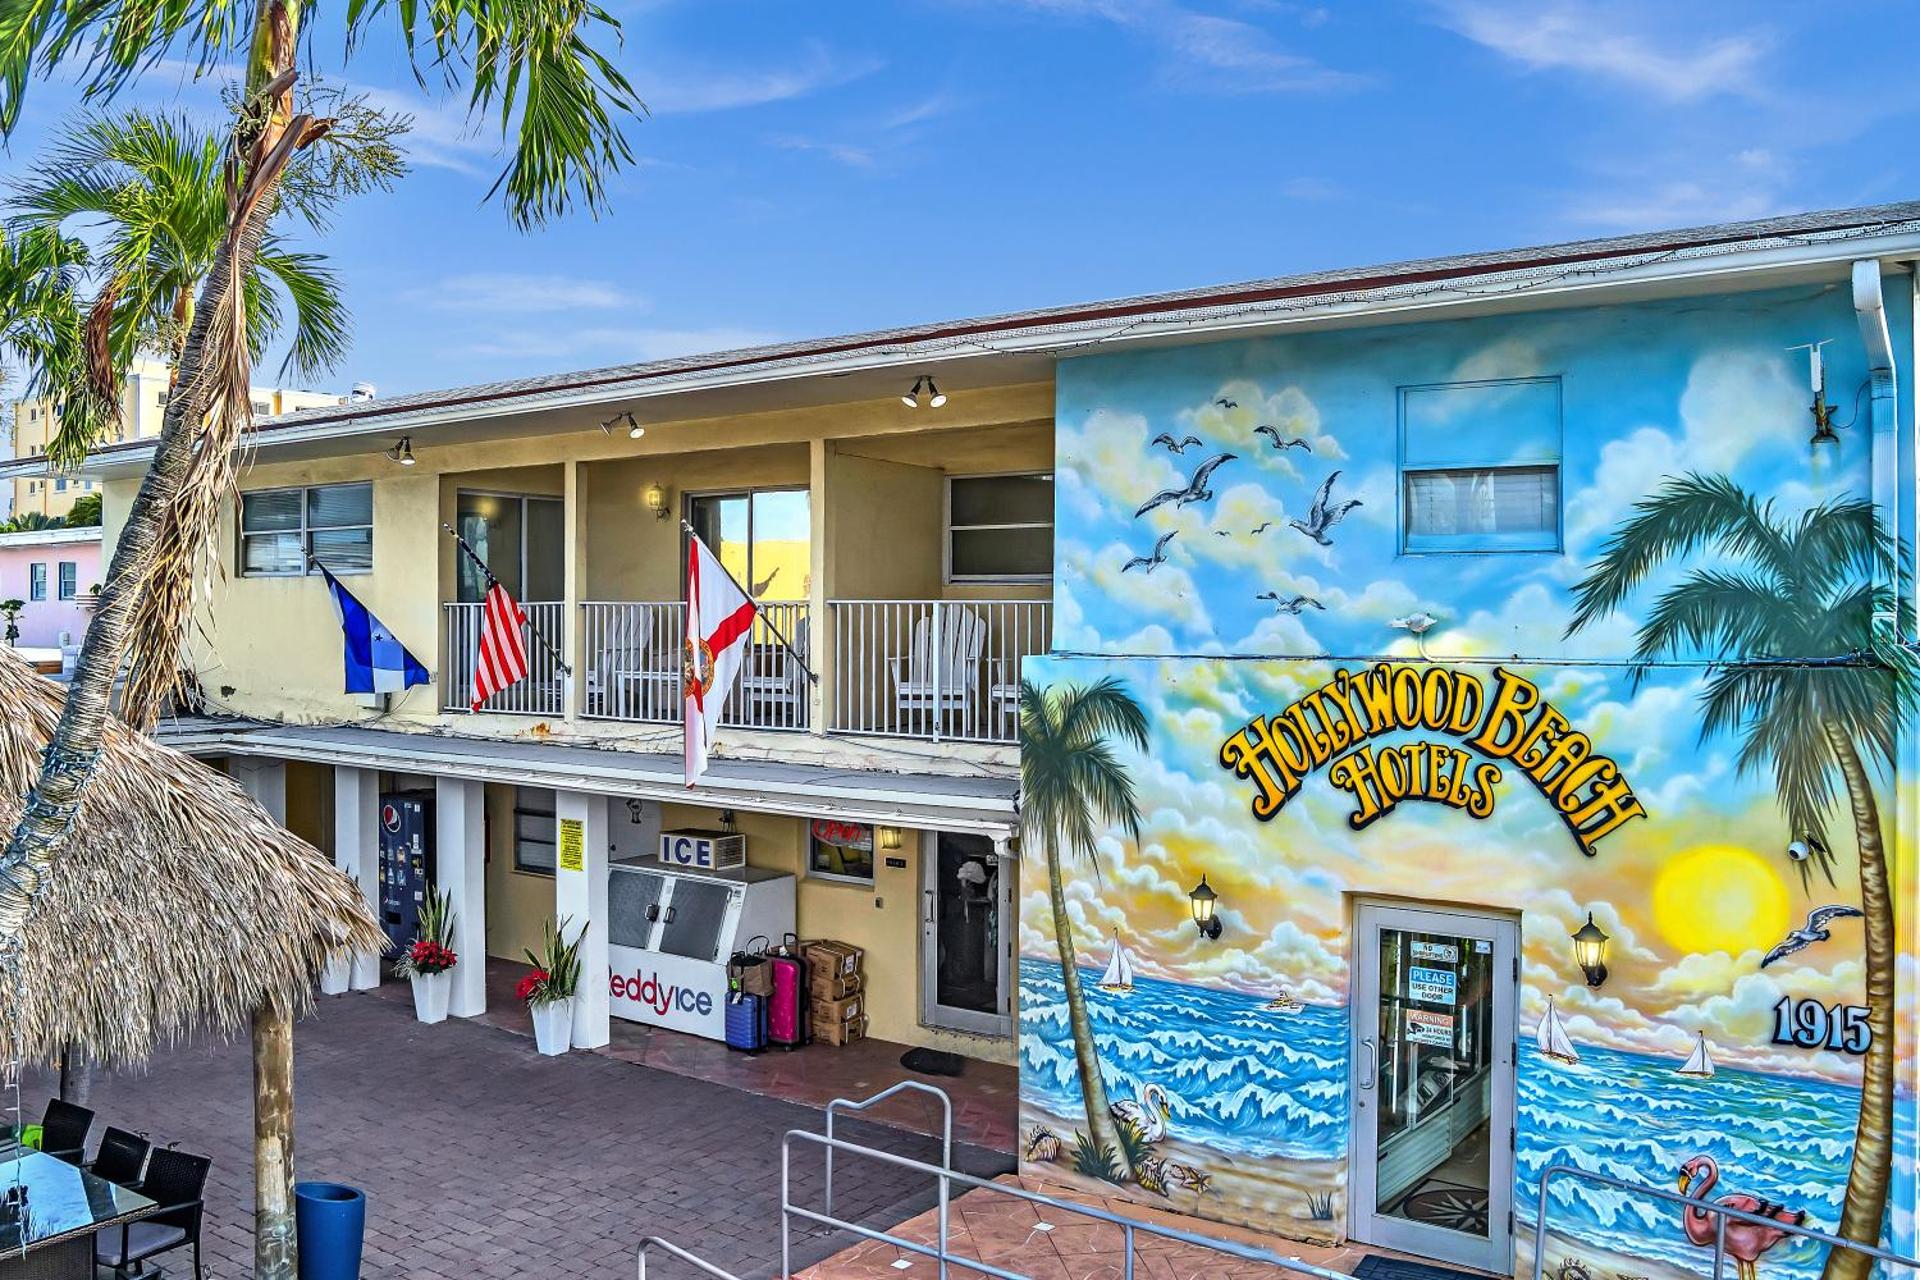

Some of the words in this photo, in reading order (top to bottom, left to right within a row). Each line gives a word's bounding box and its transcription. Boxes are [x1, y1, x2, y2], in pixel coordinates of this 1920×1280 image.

[1220, 663, 1484, 822] HOLLYWOOD
[1464, 667, 1648, 858] BEACH
[1329, 742, 1502, 832] HOTELS
[663, 836, 710, 867] ICE
[1412, 983, 1428, 991] USE
[1429, 985, 1454, 994] OTHER
[1413, 970, 1453, 985] PLEASE
[1421, 992, 1444, 1001] DOOR
[1771, 995, 1874, 1056] 1915
